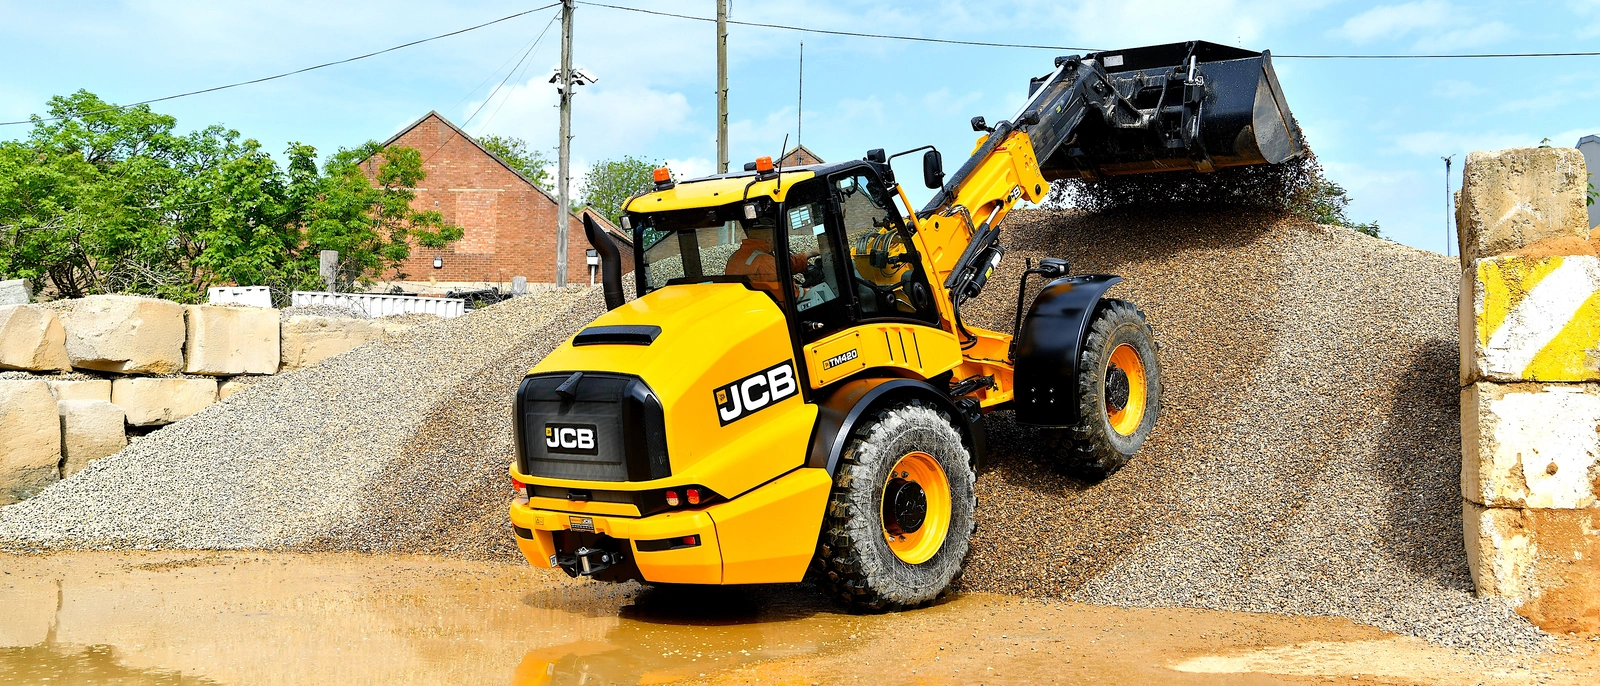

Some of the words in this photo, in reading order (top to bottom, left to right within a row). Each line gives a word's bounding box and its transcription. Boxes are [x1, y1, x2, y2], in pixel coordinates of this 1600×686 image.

[830, 349, 857, 367] TM420
[719, 364, 796, 422] JCB
[546, 427, 595, 449] JCB
